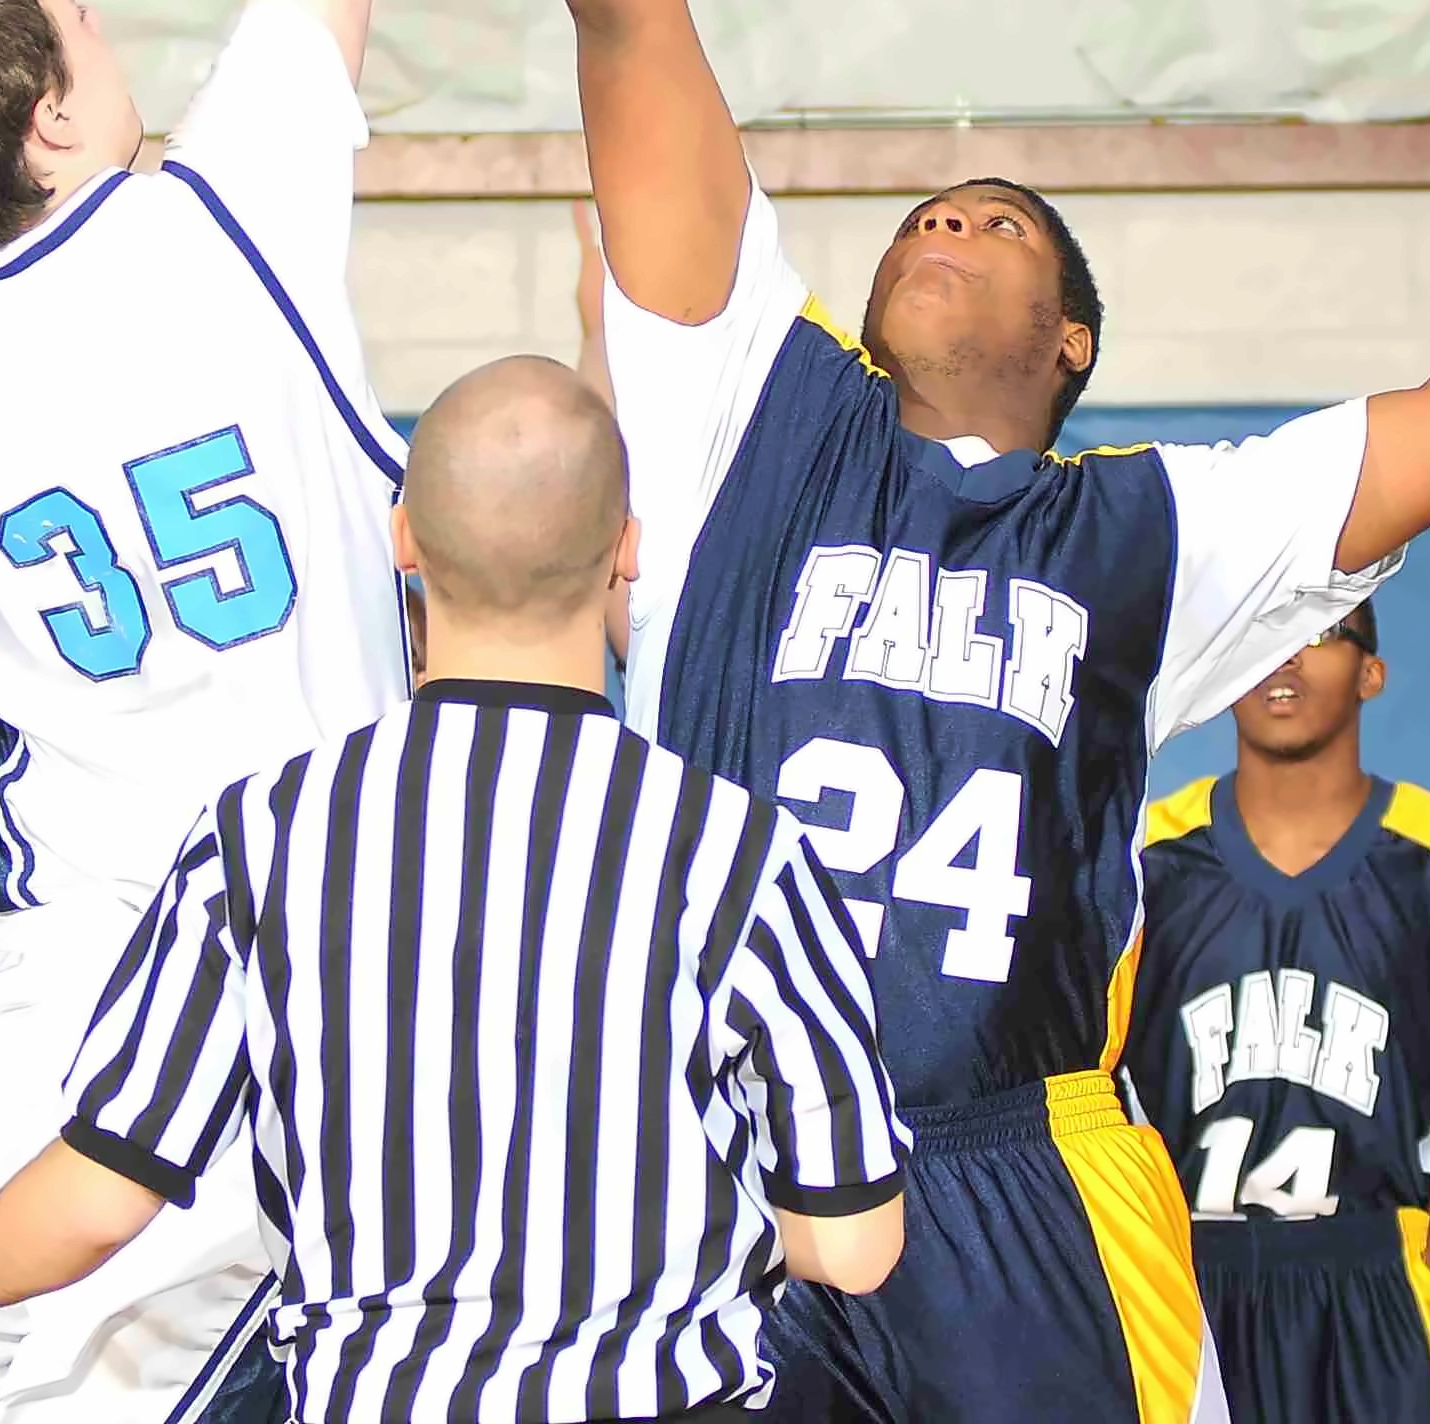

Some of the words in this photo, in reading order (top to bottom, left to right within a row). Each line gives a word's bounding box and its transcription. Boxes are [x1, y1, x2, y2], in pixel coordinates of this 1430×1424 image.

[771, 545, 1089, 749] FALK
[776, 737, 1033, 984] 24
[1180, 967, 1389, 1117] FALK
[1191, 1116, 1340, 1221] 14
